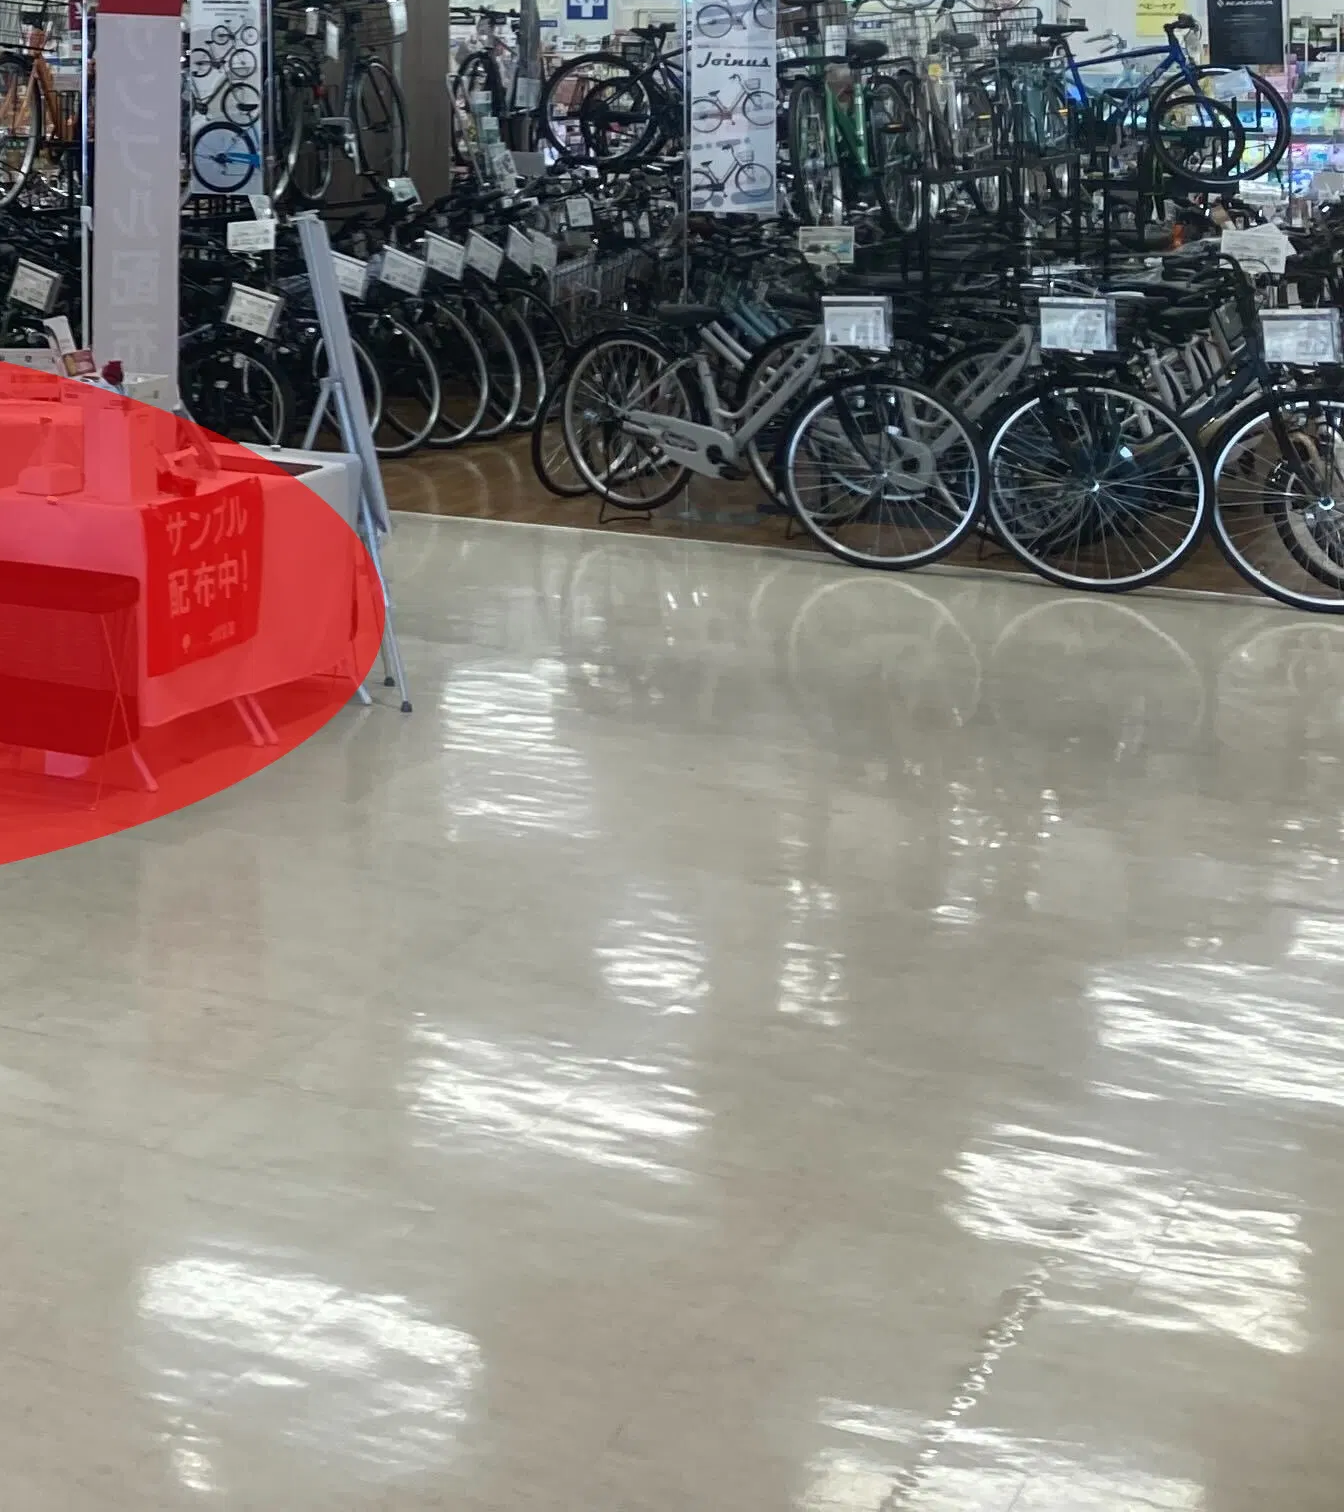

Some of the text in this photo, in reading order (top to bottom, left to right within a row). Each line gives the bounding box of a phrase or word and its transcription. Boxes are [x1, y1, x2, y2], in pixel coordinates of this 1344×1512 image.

[696, 51, 772, 68] Joinus
[165, 495, 248, 557] サンプル
[167, 549, 249, 619] 配布中!
